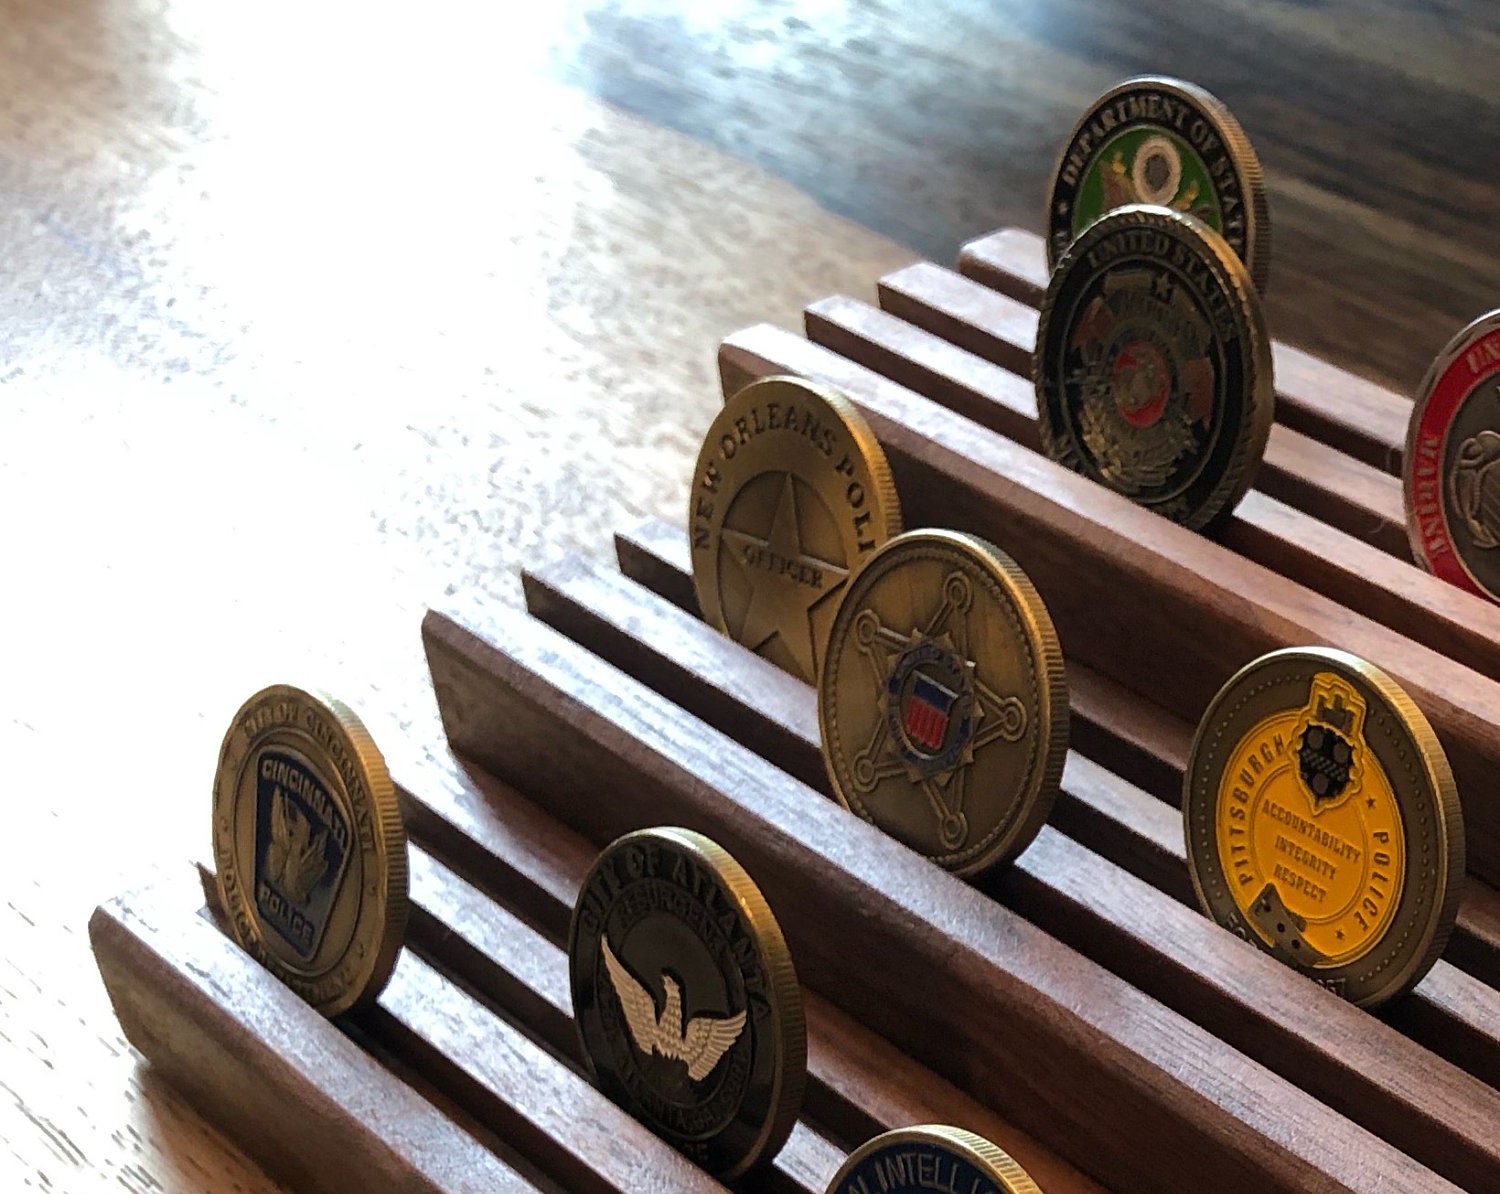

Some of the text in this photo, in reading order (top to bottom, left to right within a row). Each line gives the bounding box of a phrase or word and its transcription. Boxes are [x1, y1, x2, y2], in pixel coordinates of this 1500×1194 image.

[719, 404, 837, 461] ORLEANS
[835, 457, 876, 553] POLI
[262, 758, 348, 850] CINCINNATI
[1229, 733, 1287, 886] PITTSBURGH
[1261, 798, 1363, 864] ACCOUNTABILITY
[1272, 863, 1328, 902] RESPECT
[1274, 834, 1338, 880] INTEGRITY
[1352, 830, 1391, 932] POLICE
